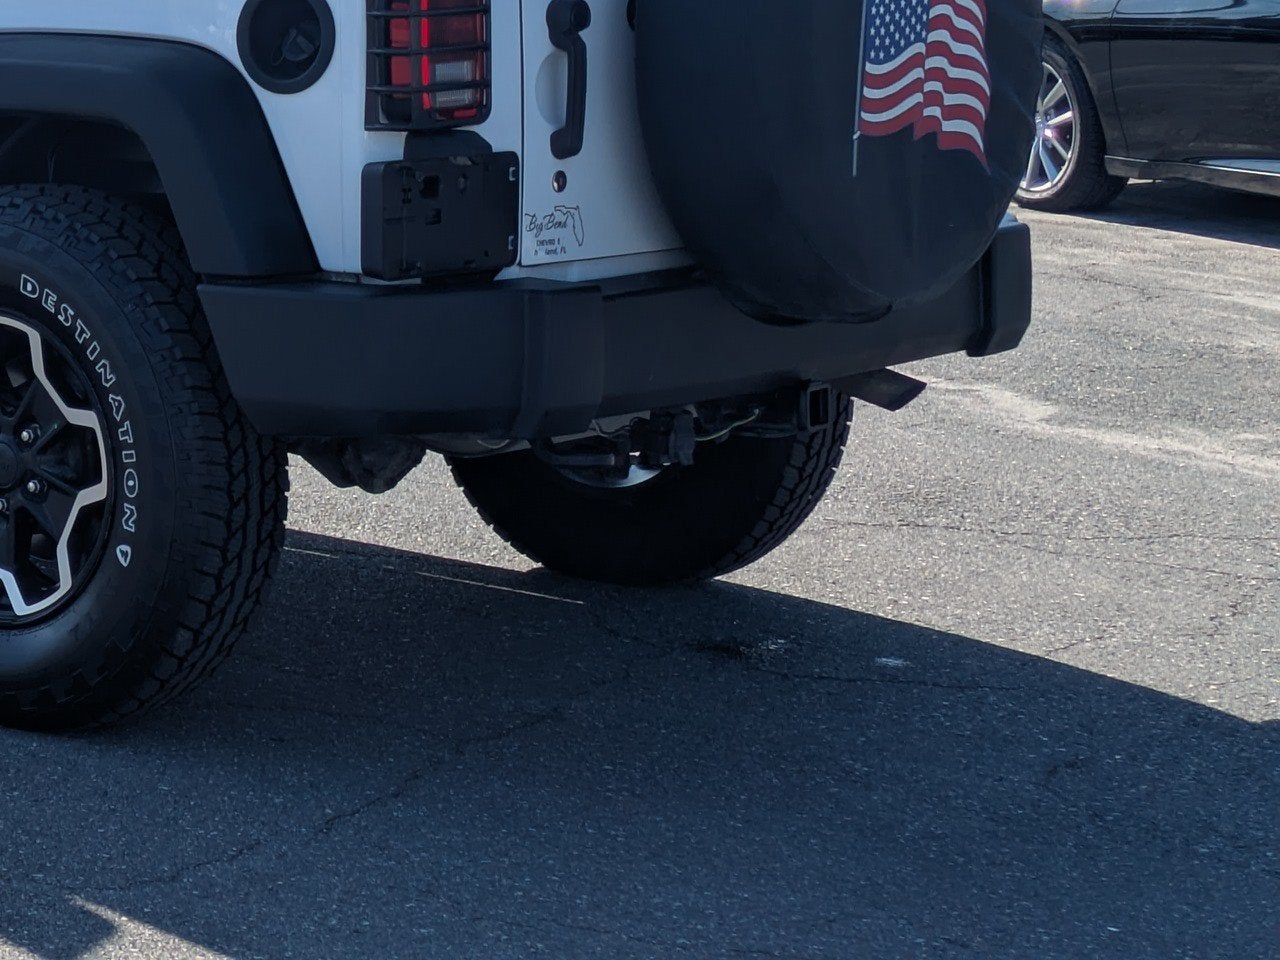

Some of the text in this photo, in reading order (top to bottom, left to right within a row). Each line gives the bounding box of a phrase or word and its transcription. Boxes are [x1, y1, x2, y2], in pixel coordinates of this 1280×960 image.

[524, 212, 569, 238] Big Bend
[19, 274, 139, 532] DESTINATION
